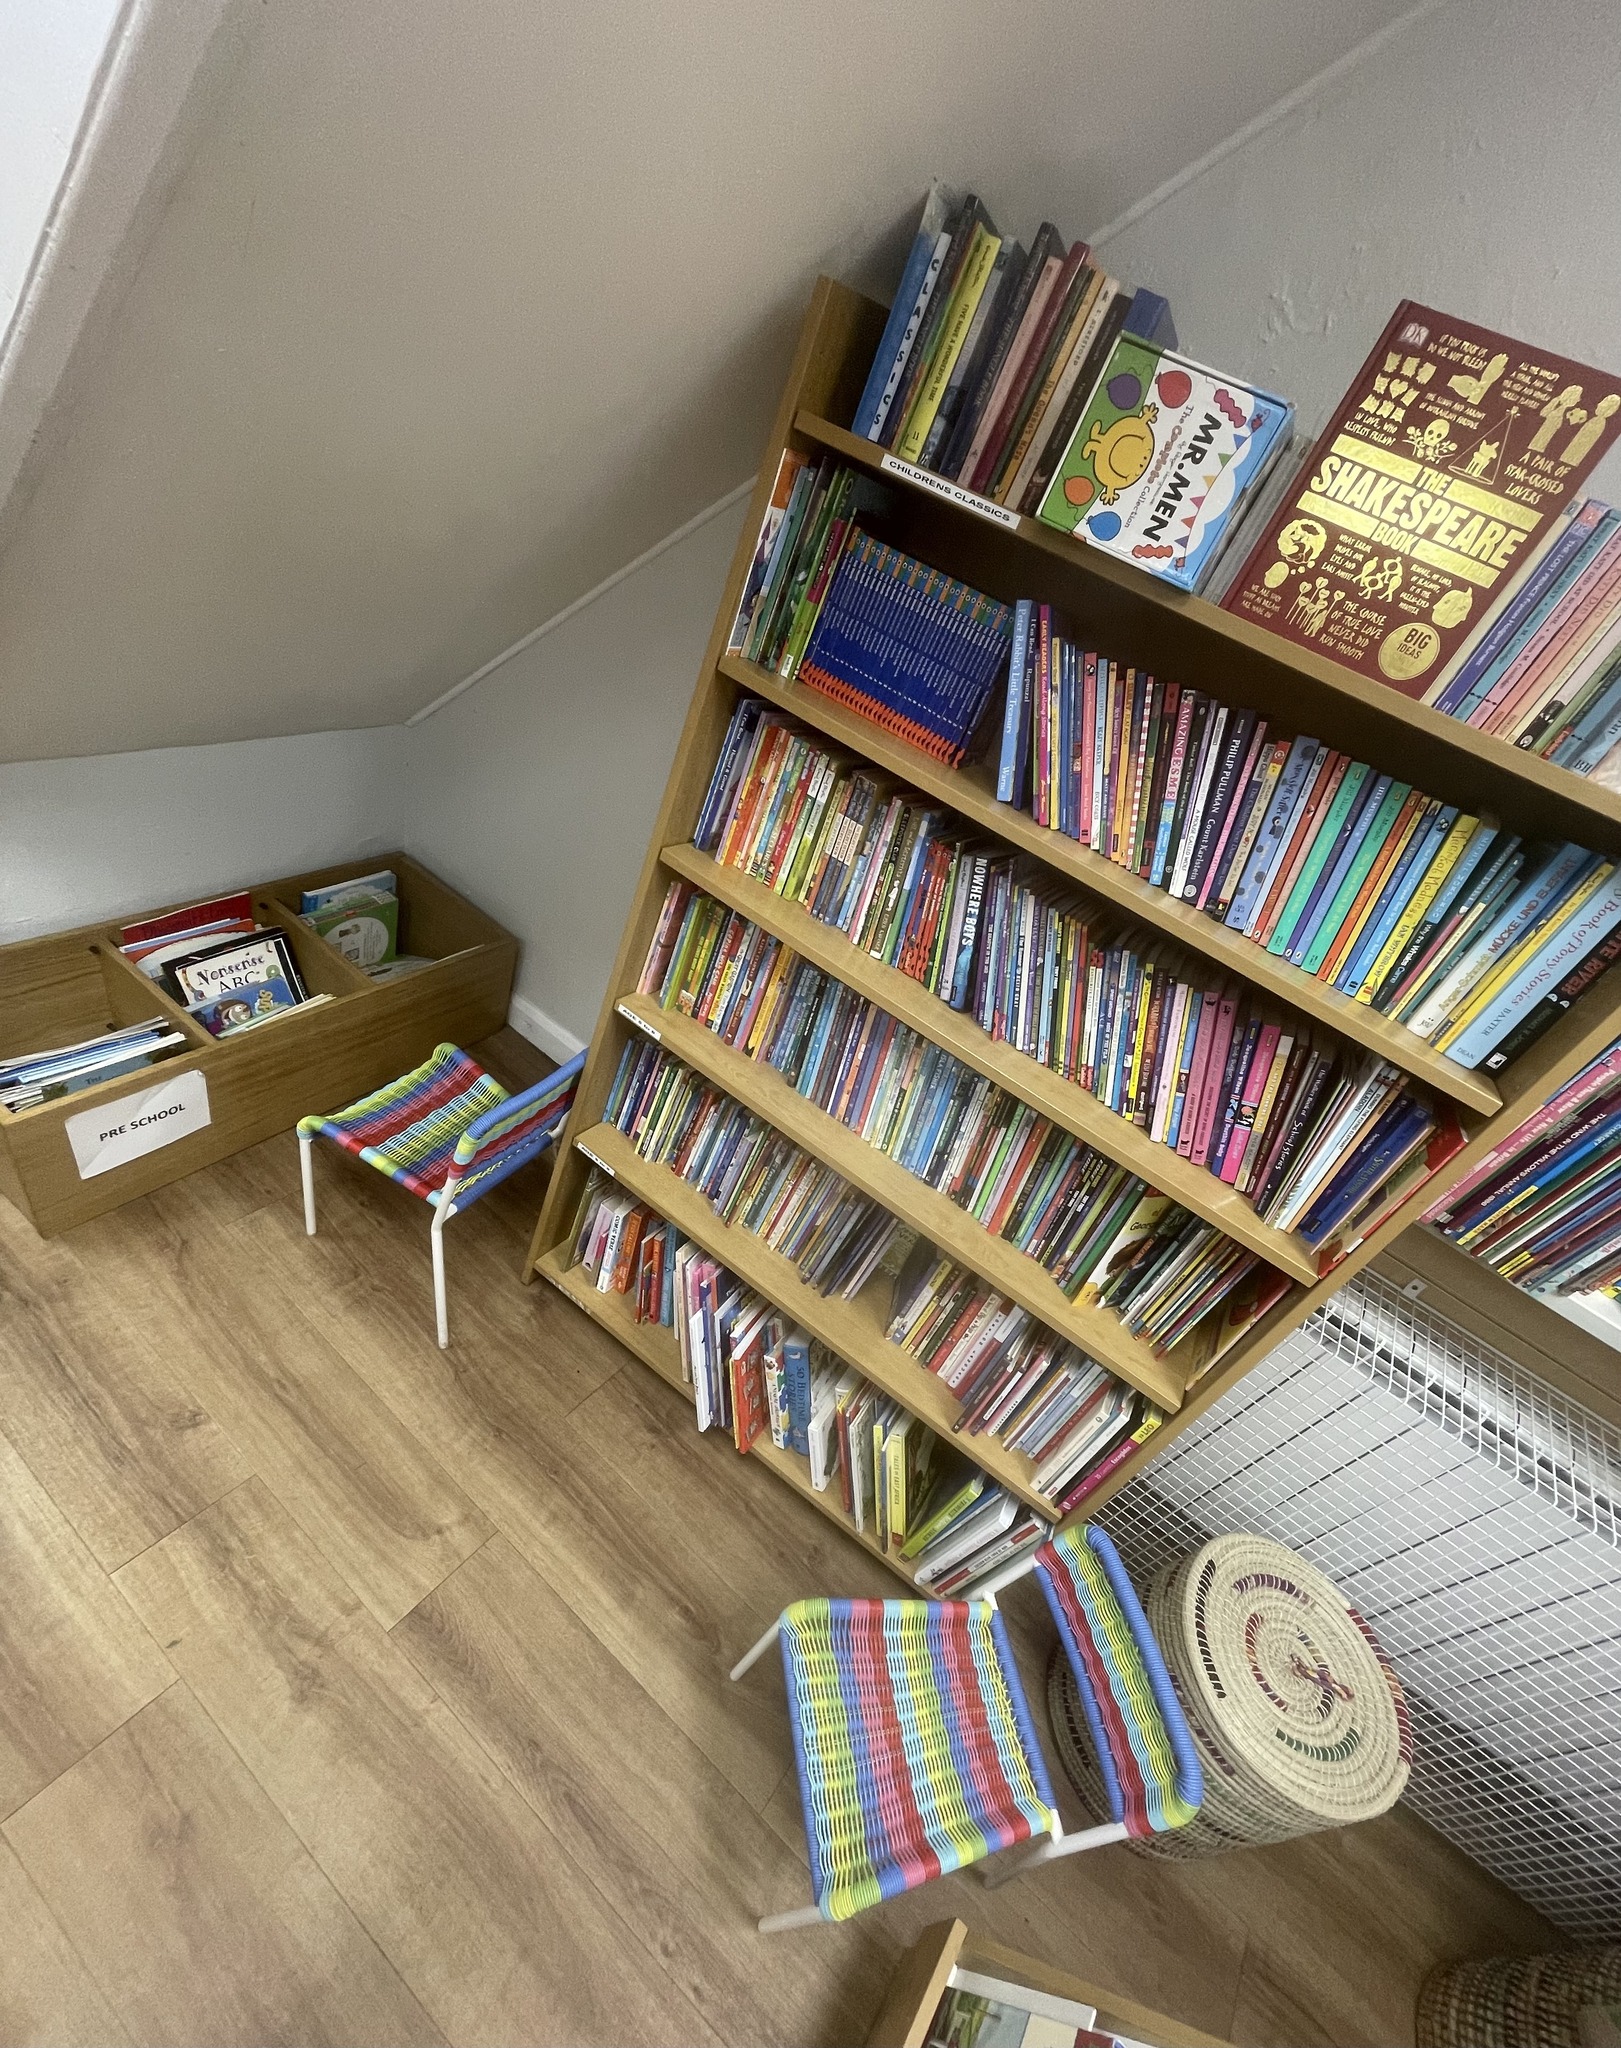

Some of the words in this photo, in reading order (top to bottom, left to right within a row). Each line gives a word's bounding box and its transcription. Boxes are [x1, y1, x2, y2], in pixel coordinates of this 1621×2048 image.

[960, 304, 969, 320] FIVE
[956, 320, 964, 337] HAVE
[937, 345, 954, 384] WONDERFUL
[929, 385, 939, 402] TIME
[1179, 405, 1194, 424] The
[1384, 422, 1398, 433] WHO
[1147, 425, 1182, 484] Complete
[1519, 451, 1531, 463] A
[1531, 453, 1555, 473] PAIR
[1555, 465, 1571, 477] OF
[889, 461, 952, 494] CHILDRENS
[954, 491, 1010, 522] CLASSICS
[1417, 467, 1452, 496] THE
[1504, 464, 1564, 495] STAR-CROSSED
[1505, 482, 1543, 505] LOVERS
[1125, 486, 1150, 528] Collection
[1310, 456, 1528, 569] SHAKESPEARE
[1339, 534, 1356, 546] WHAT
[1371, 521, 1420, 555] BOOK
[1560, 538, 1575, 555] THE
[1330, 554, 1343, 565] EYES
[1344, 560, 1356, 569] AND
[1546, 553, 1564, 573] LOST
[1527, 571, 1550, 598] PRINCE
[1016, 608, 1026, 631] Peter
[1331, 610, 1342, 620] OF
[1345, 615, 1363, 629] TRUE
[1361, 623, 1383, 640] LOVE
[1342, 600, 1359, 614] THE
[1360, 607, 1387, 627] COURSE
[1319, 633, 1337, 647] RUN
[1338, 641, 1365, 660] SMOOTH
[1328, 624, 1353, 643] NEVER
[1355, 634, 1370, 648] DID
[1404, 628, 1432, 650] BIG
[1014, 635, 1023, 669] Rabbit's
[1040, 642, 1048, 674] READERS
[1397, 643, 1422, 659] IDEAS
[1010, 672, 1020, 696] Little
[1004, 699, 1016, 735] Treasury
[1175, 707, 1191, 755] AMAZING
[1229, 738, 1240, 768] PHILIP
[1260, 744, 1274, 765] Hippo
[999, 766, 1009, 793] Warne
[1166, 758, 1182, 799] ESME
[1213, 769, 1231, 813] PULLMAN
[1249, 787, 1258, 798] The
[1373, 784, 1385, 801] JILL
[1190, 814, 1199, 834] MOUSE
[1236, 797, 1254, 828] Children
[1358, 799, 1377, 832] MURPHY
[1206, 818, 1215, 844] Count
[1230, 825, 1243, 843] Next
[1185, 835, 1194, 856] CALLED
[1225, 843, 1237, 860] Door
[1181, 856, 1189, 871] WOLF
[1191, 844, 1208, 880] Karlstein
[969, 858, 988, 915] NOWHERE
[1404, 872, 1443, 923] Madness
[1516, 899, 1539, 921] UND
[1582, 900, 1619, 930] Book
[962, 917, 978, 946] BOYS
[1017, 936, 1025, 946] The
[1395, 922, 1410, 939] IAN
[1419, 921, 1433, 937] Why
[1572, 928, 1586, 946] of
[1372, 937, 1401, 978] WHYBROW
[1399, 942, 1420, 967] Whales
[1546, 941, 1576, 967] Pony
[197, 955, 265, 985] Nonsense
[1388, 964, 1405, 985] Came
[1562, 957, 1606, 995] RIVER
[1512, 969, 1552, 1007] Stories
[1097, 1012, 1106, 1028] ACE
[1481, 1007, 1511, 1037] BAXTER
[1240, 1044, 1253, 1072] Jacqueline
[1233, 1073, 1243, 1094] Wilson
[1308, 1077, 1321, 1098] Walker
[1589, 1065, 1616, 1089] People
[1303, 1096, 1313, 1110] Book
[1353, 1087, 1374, 1113] ALADDIN
[1366, 1092, 1380, 1110] DUMBO
[1575, 1084, 1594, 1101] Then
[1556, 1099, 1573, 1115] Now
[1588, 1111, 1605, 1126] THE
[100, 1125, 127, 1142] PRE
[130, 1103, 185, 1129] SCHOOL
[1350, 1116, 1363, 1131] FLYING
[1518, 1110, 1546, 1134] Number
[1530, 1120, 1547, 1135] New
[1569, 1122, 1590, 1141] WIND
[1285, 1121, 1303, 1149] School
[1337, 1129, 1354, 1151] ELEPHANT
[1518, 1131, 1533, 1145] Life
[1275, 1147, 1291, 1171] Stories
[1486, 1149, 1510, 1170] Britain
[1547, 1141, 1564, 1156] THE
[1519, 1151, 1550, 1178] WILLOWS
[1494, 1174, 1521, 1197] ANNUAL
[610, 1215, 621, 1234] COMIC
[607, 1234, 616, 1251] VERSE
